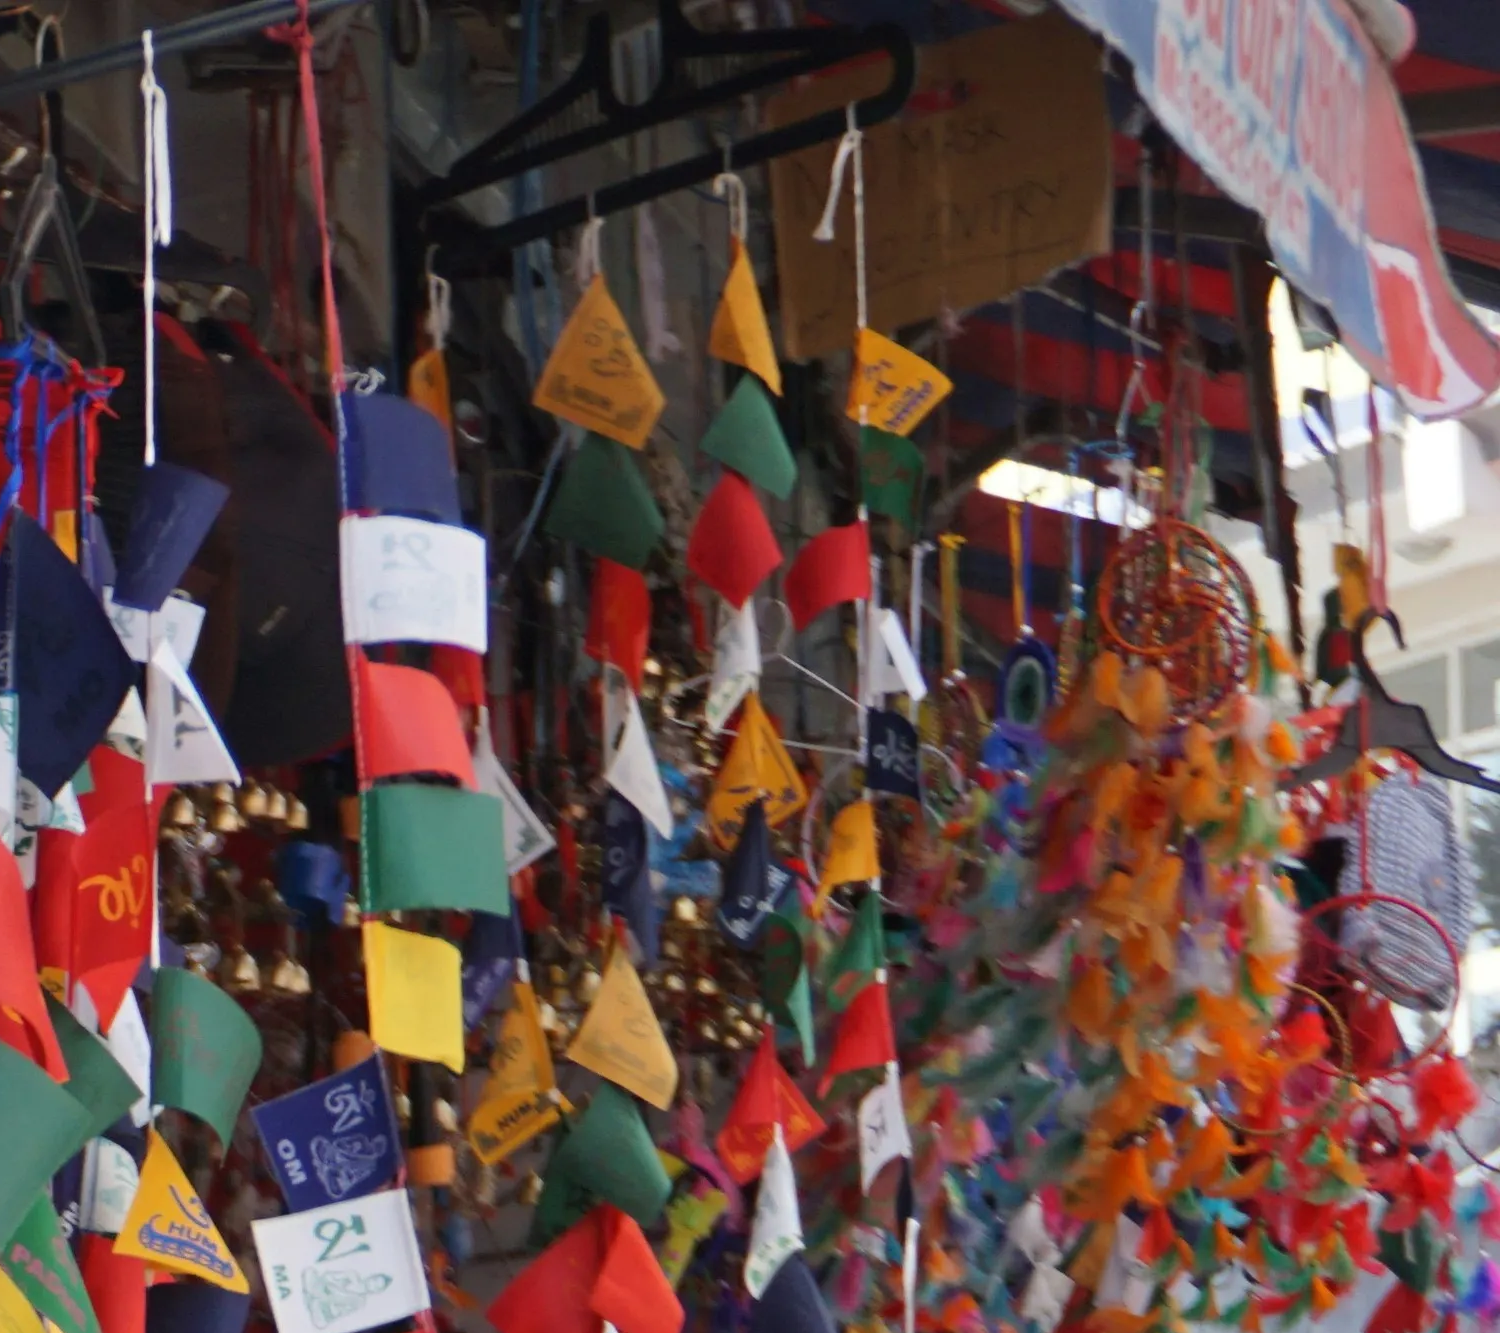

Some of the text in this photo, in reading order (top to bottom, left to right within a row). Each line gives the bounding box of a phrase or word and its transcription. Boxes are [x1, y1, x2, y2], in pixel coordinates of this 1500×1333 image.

[277, 1138, 307, 1186] OM
[168, 1220, 218, 1252] HUM
[272, 1264, 292, 1300] MA
